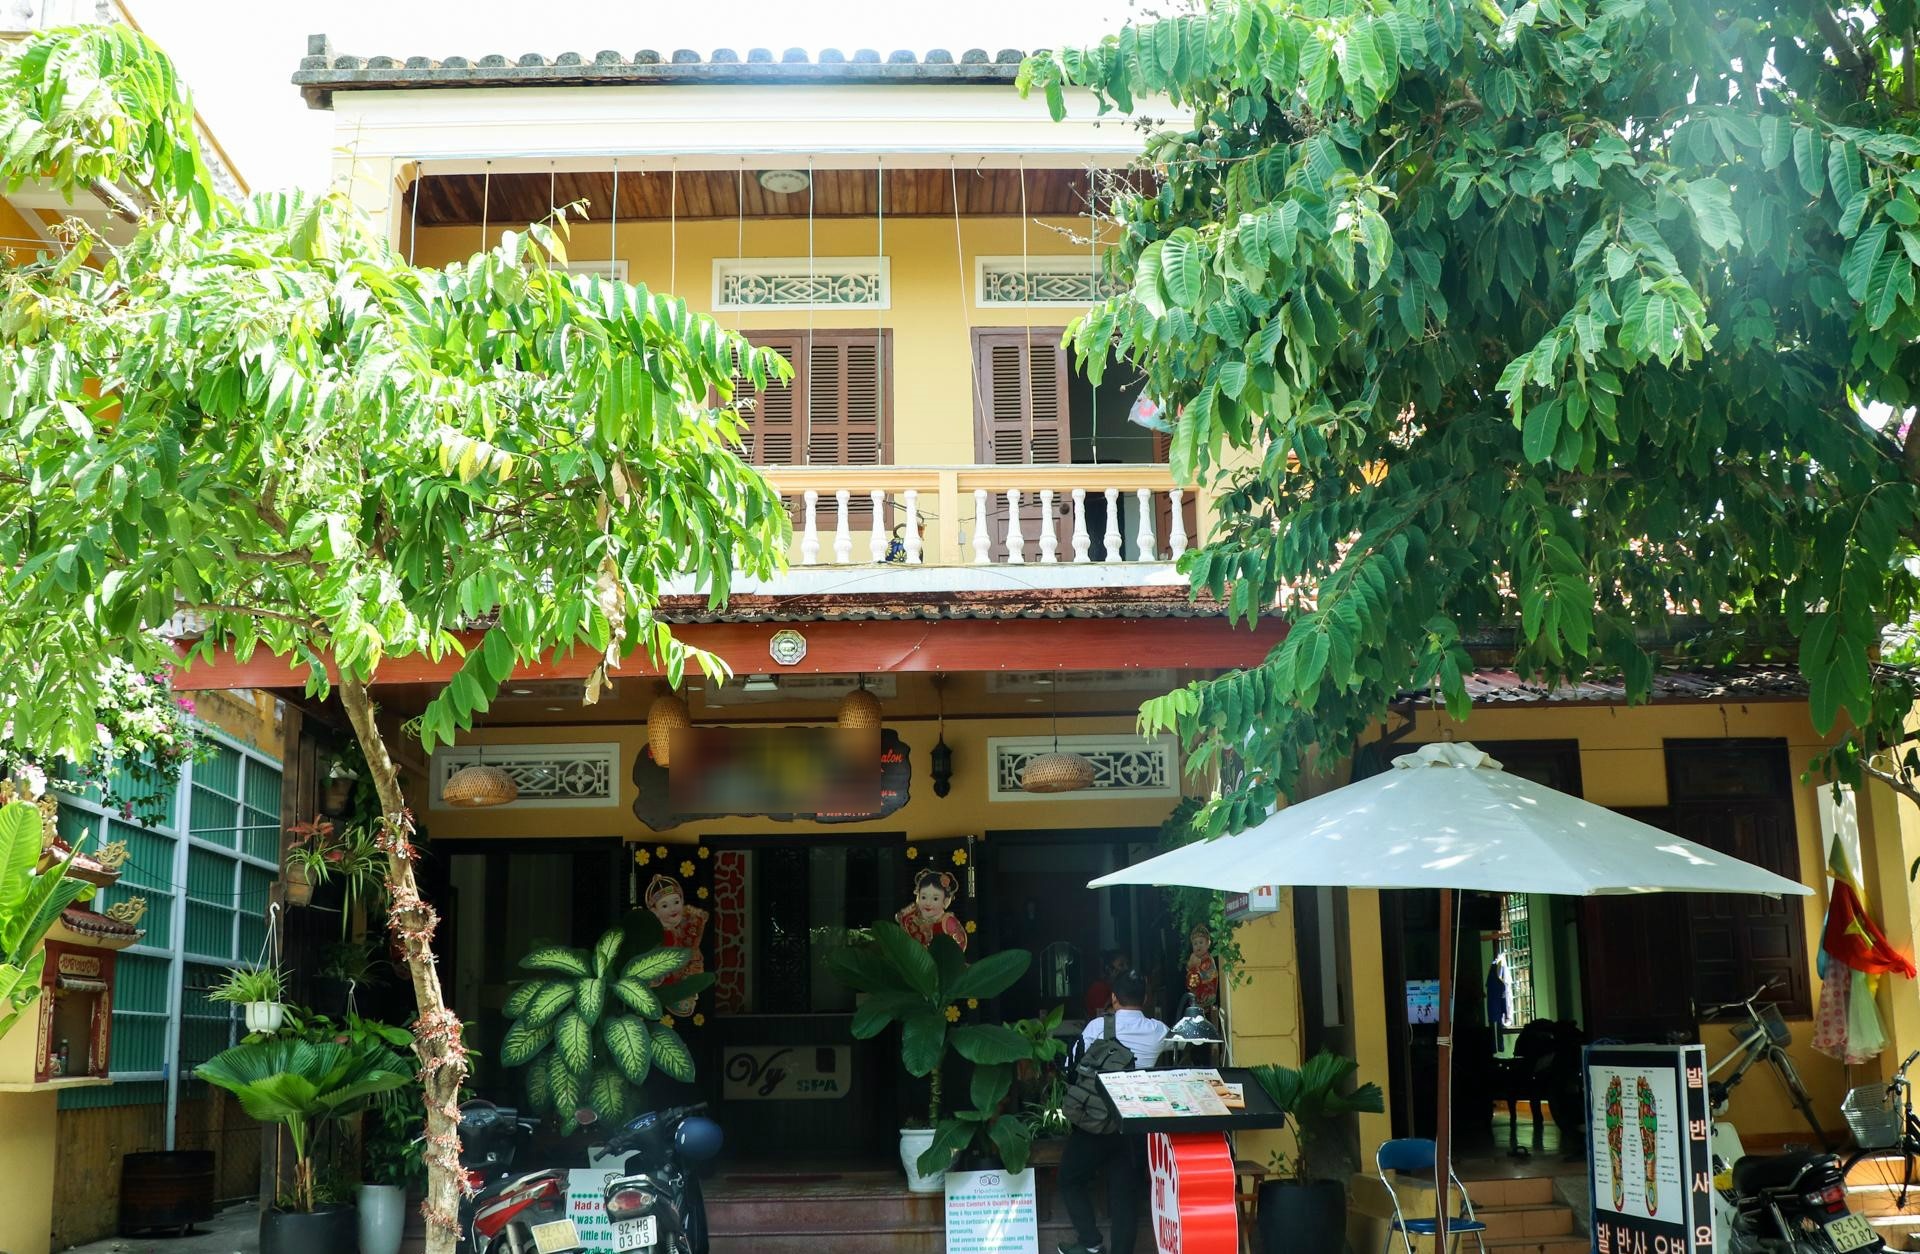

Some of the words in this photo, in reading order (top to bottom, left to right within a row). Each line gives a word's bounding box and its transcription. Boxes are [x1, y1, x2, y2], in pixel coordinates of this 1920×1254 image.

[881, 749, 904, 763] alon
[725, 1047, 793, 1096] Vy
[796, 1079, 838, 1092] SPA
[1155, 1176, 1165, 1211] FOOT
[574, 1200, 592, 1210] Had
[577, 1215, 594, 1224] was
[595, 1213, 608, 1224] nic
[580, 1230, 599, 1240] little
[618, 1219, 649, 1235] 92-H8
[1159, 1215, 1178, 1254] MASSAGE
[619, 1233, 650, 1249] 0305
[1837, 1228, 1875, 1251] 137.82
